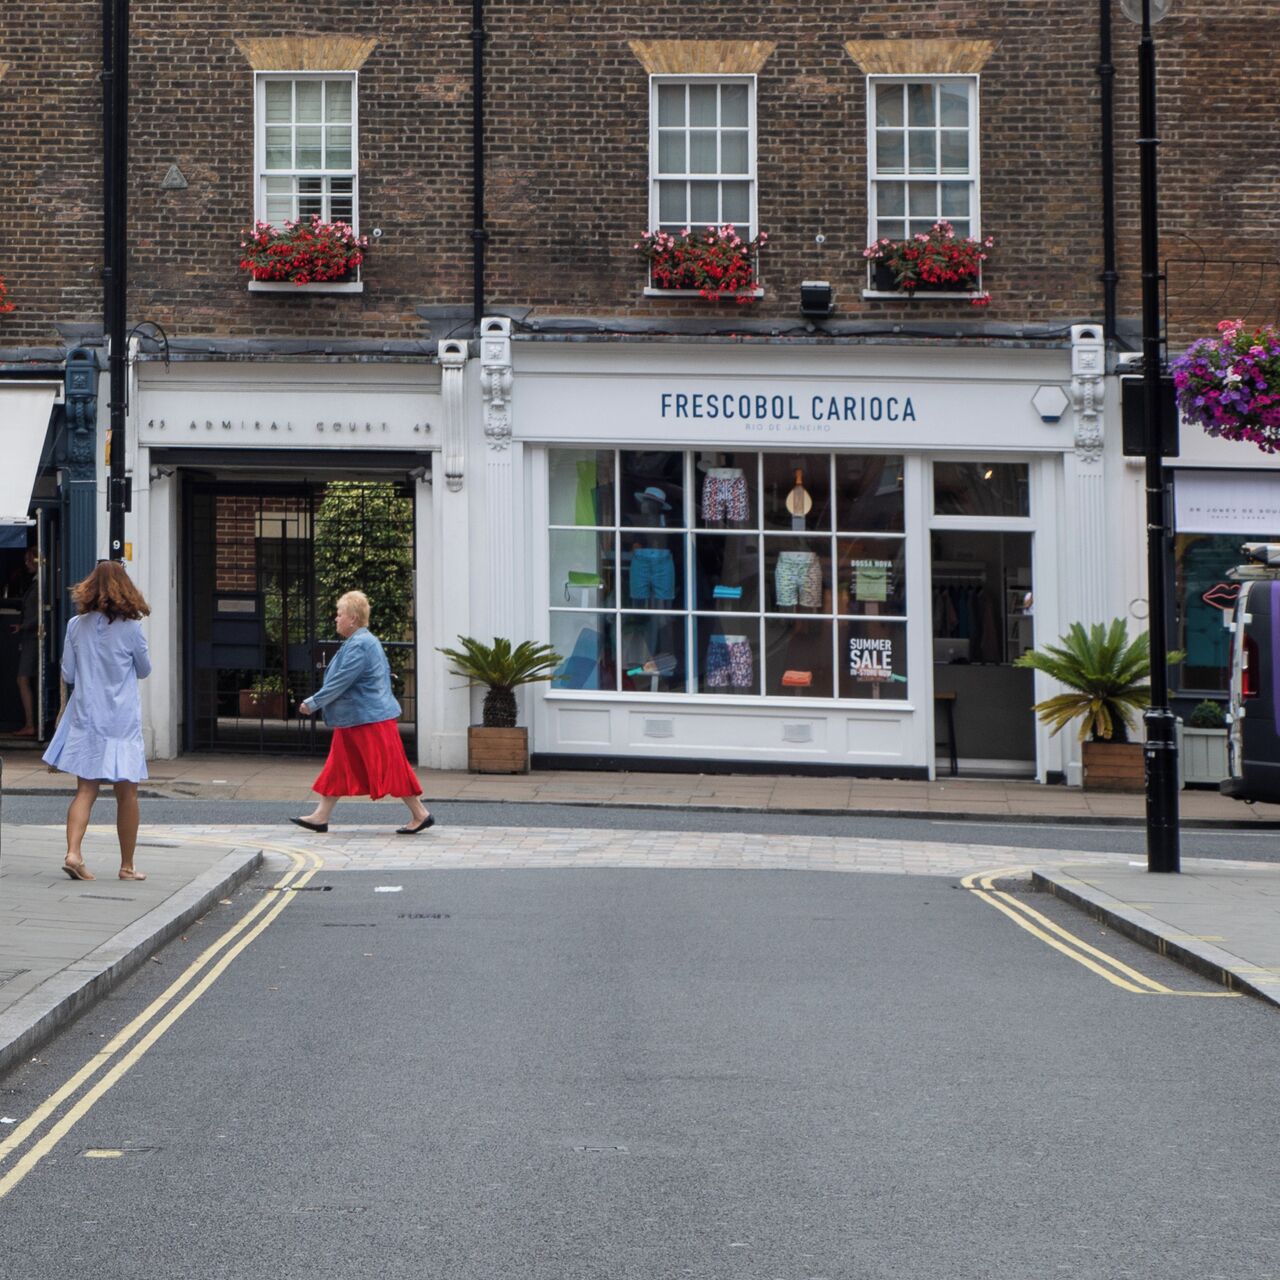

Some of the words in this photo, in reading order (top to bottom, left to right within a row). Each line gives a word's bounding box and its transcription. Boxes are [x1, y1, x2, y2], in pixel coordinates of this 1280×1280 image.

[661, 394, 800, 420] FRESCOBOL
[812, 396, 917, 422] CARIOCA
[190, 421, 293, 432] ADMIRAL
[316, 421, 389, 432] COURT
[745, 424, 764, 432] RIO
[768, 424, 782, 432] DE
[786, 424, 831, 433] JANEIRO
[112, 540, 121, 550] 9
[850, 638, 892, 651] SUMMER
[850, 650, 892, 670] SALE
